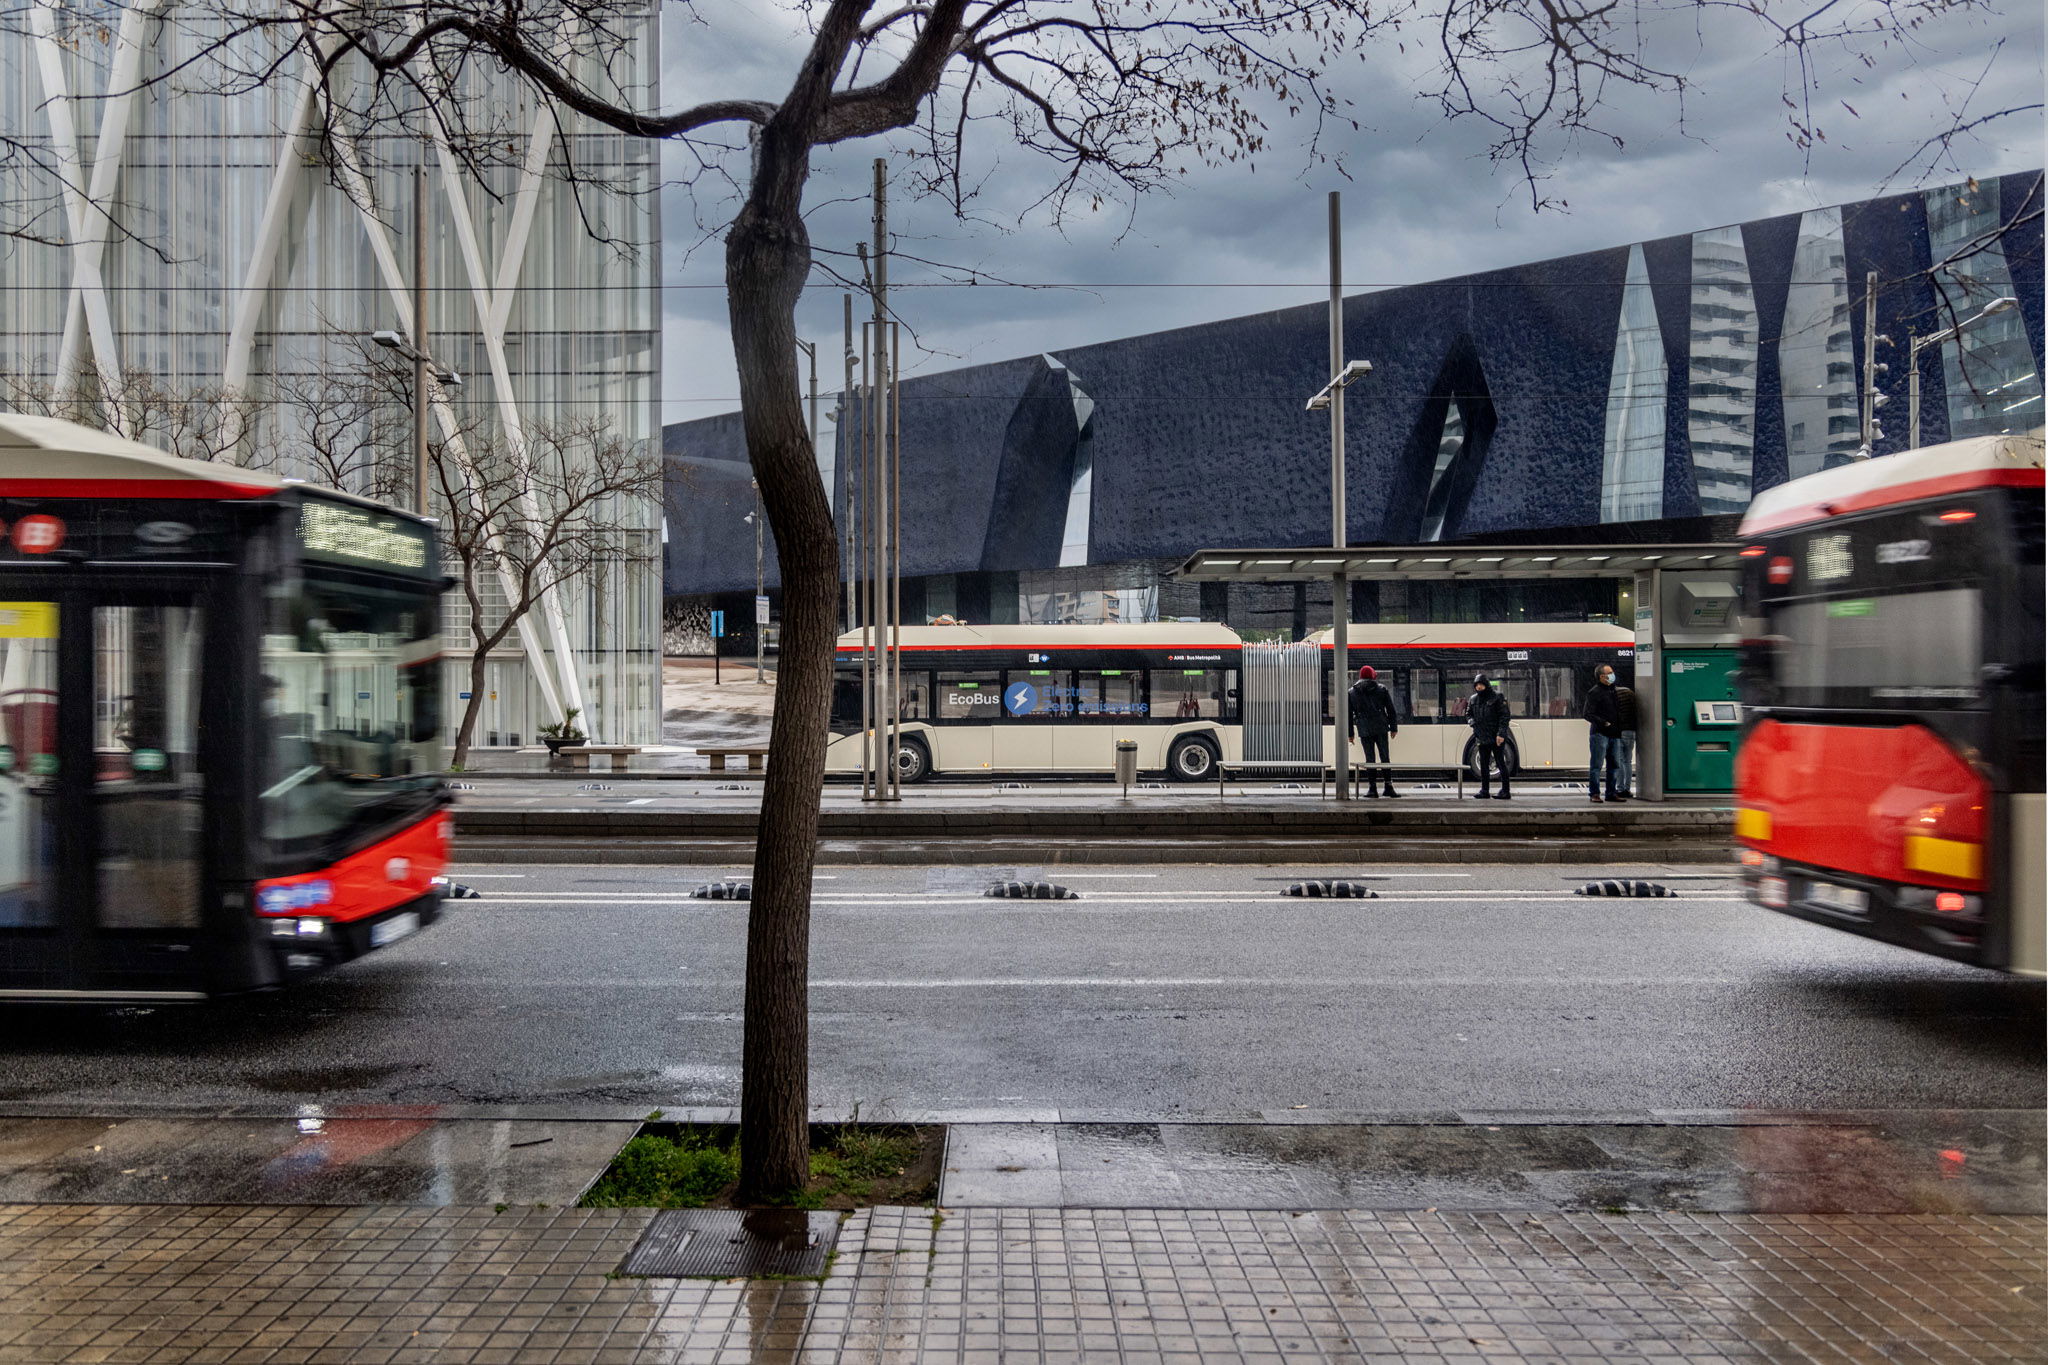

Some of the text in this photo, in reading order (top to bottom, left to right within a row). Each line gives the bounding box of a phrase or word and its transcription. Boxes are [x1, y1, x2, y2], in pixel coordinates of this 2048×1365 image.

[949, 693, 1000, 705] EcoBus
[1040, 700, 1149, 712] Zero emissions
